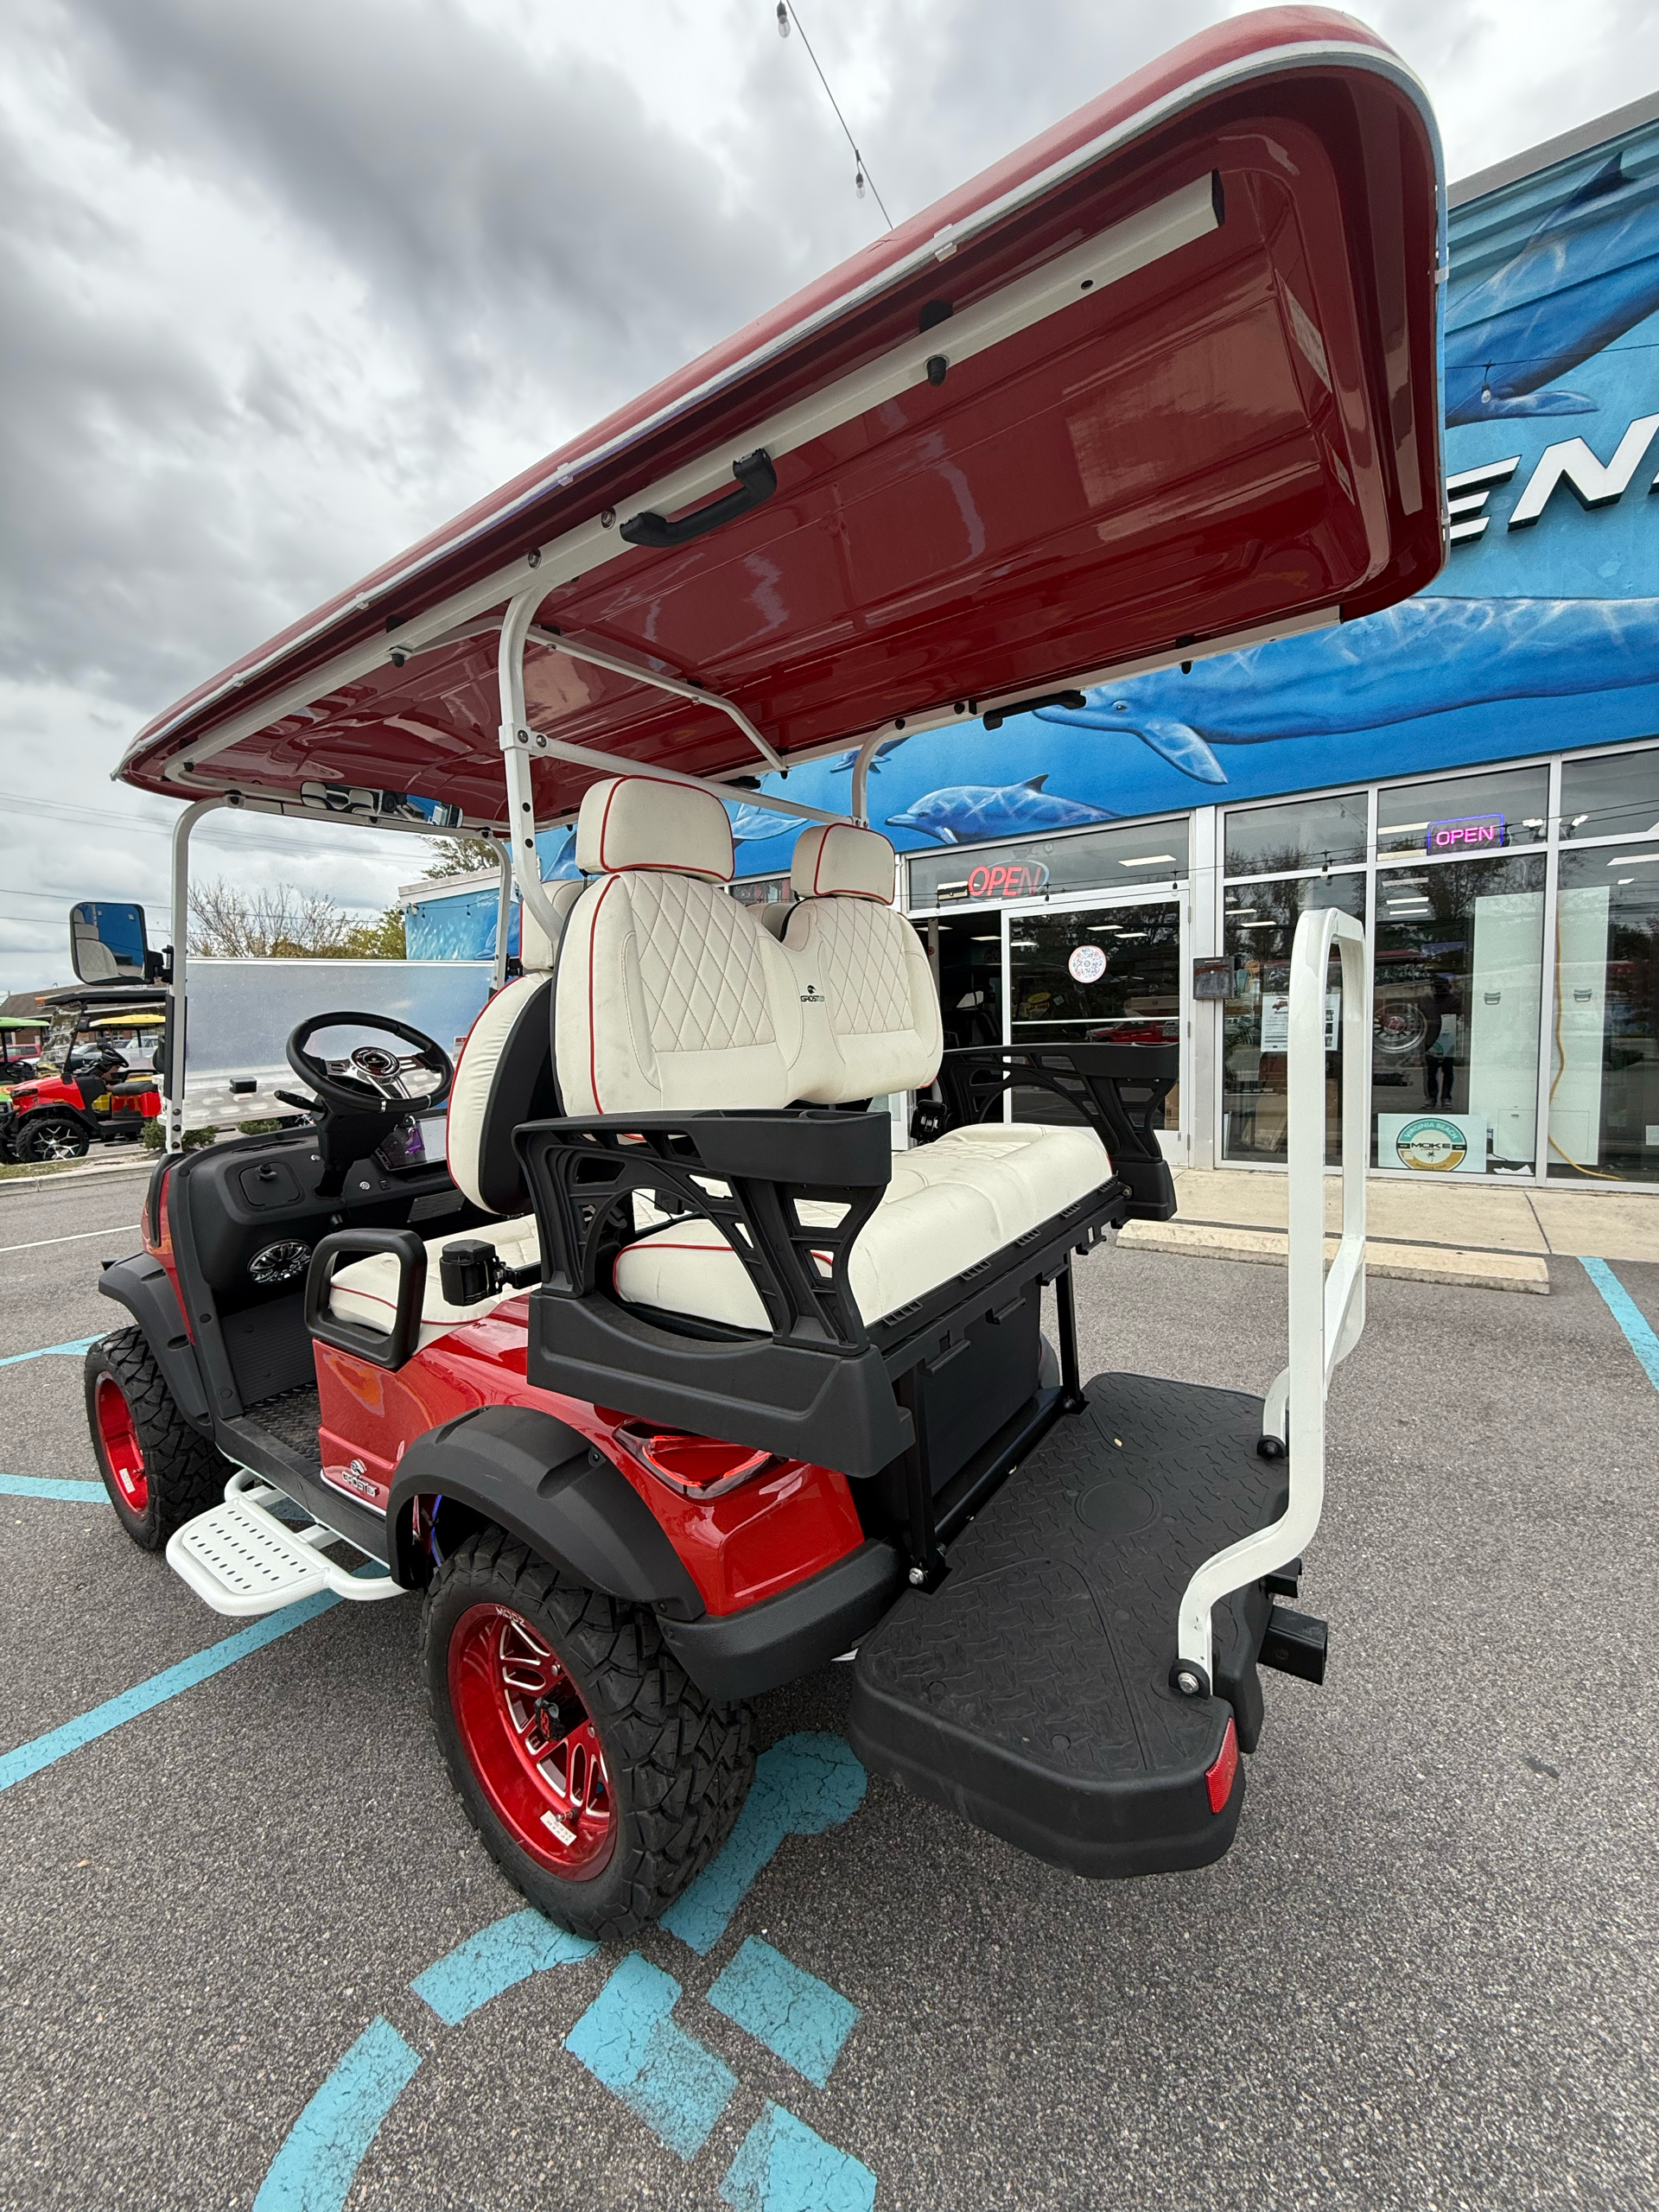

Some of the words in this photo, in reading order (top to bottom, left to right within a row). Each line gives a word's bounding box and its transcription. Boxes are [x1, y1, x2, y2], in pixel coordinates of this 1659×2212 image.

[1446, 412, 1659, 548] EN
[1435, 825, 1495, 846] OPEN
[968, 866, 1042, 897] OPEN
[1403, 1122, 1434, 1138] VIRGINIA
[1435, 1122, 1459, 1140] BEACH
[495, 1606, 526, 1628] MODZ
